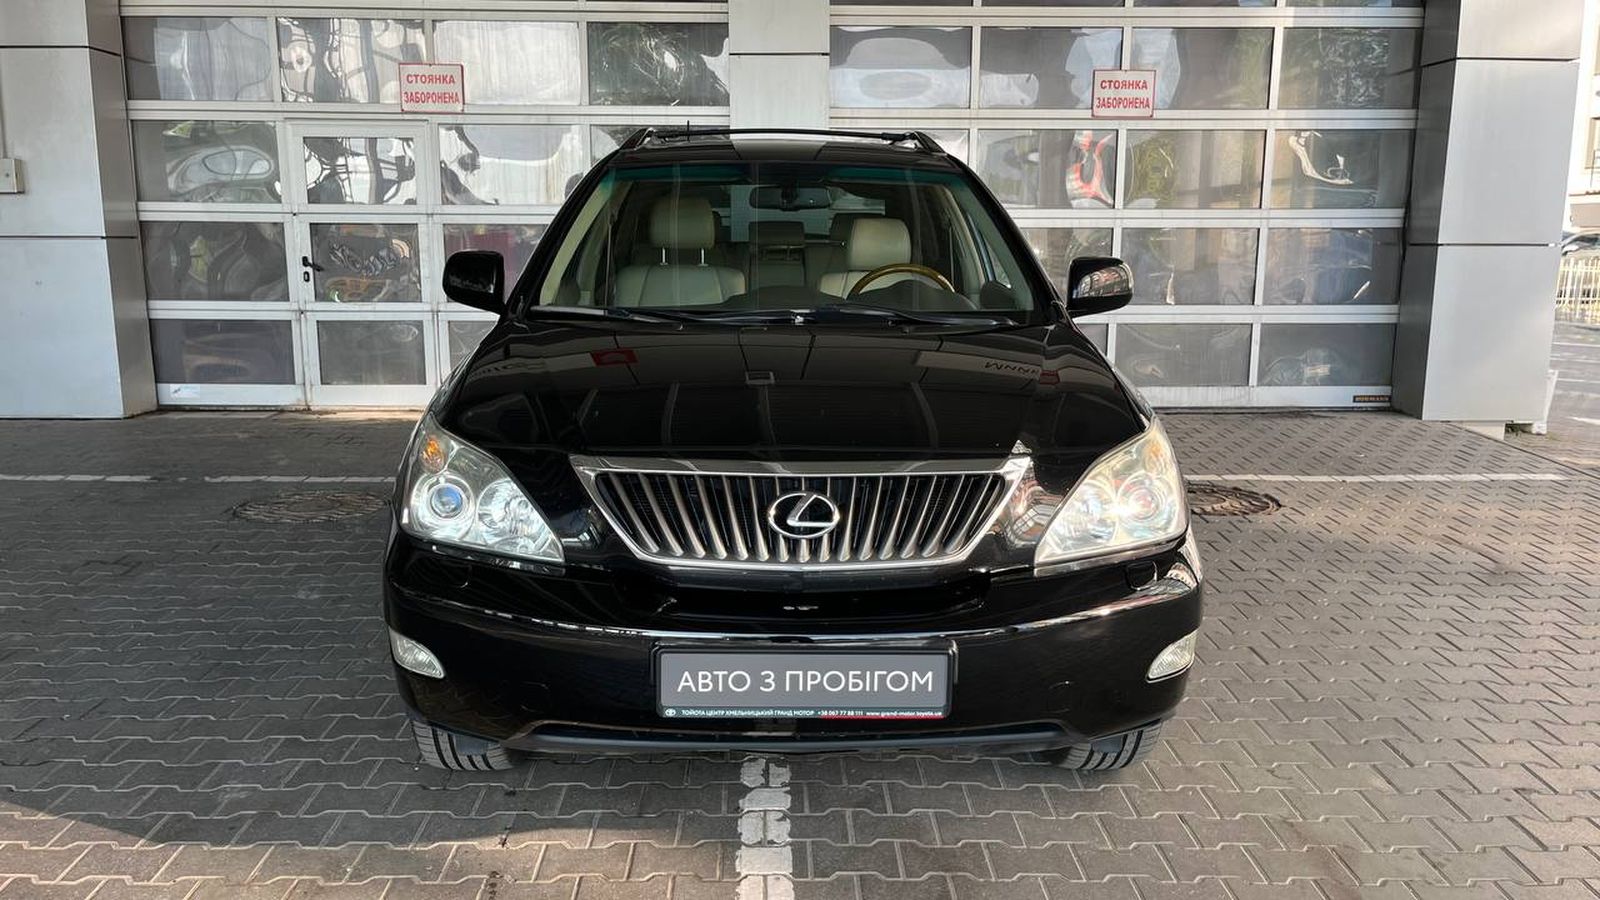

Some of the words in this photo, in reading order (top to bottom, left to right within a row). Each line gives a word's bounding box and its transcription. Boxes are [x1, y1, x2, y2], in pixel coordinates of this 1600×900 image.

[406, 74, 456, 84] СТОЯНКА
[1100, 80, 1148, 90] СТОЯНКА
[404, 91, 460, 104] ЗАБОРОНЕНА
[1096, 97, 1150, 109] ЗАБОРОНЕНА
[677, 670, 751, 692] АВТО
[759, 670, 776, 692] З
[785, 670, 933, 692] ПРОБІГОМ
[682, 708, 705, 716] ТОЙОТА
[706, 709, 725, 717] ЦЕНТР
